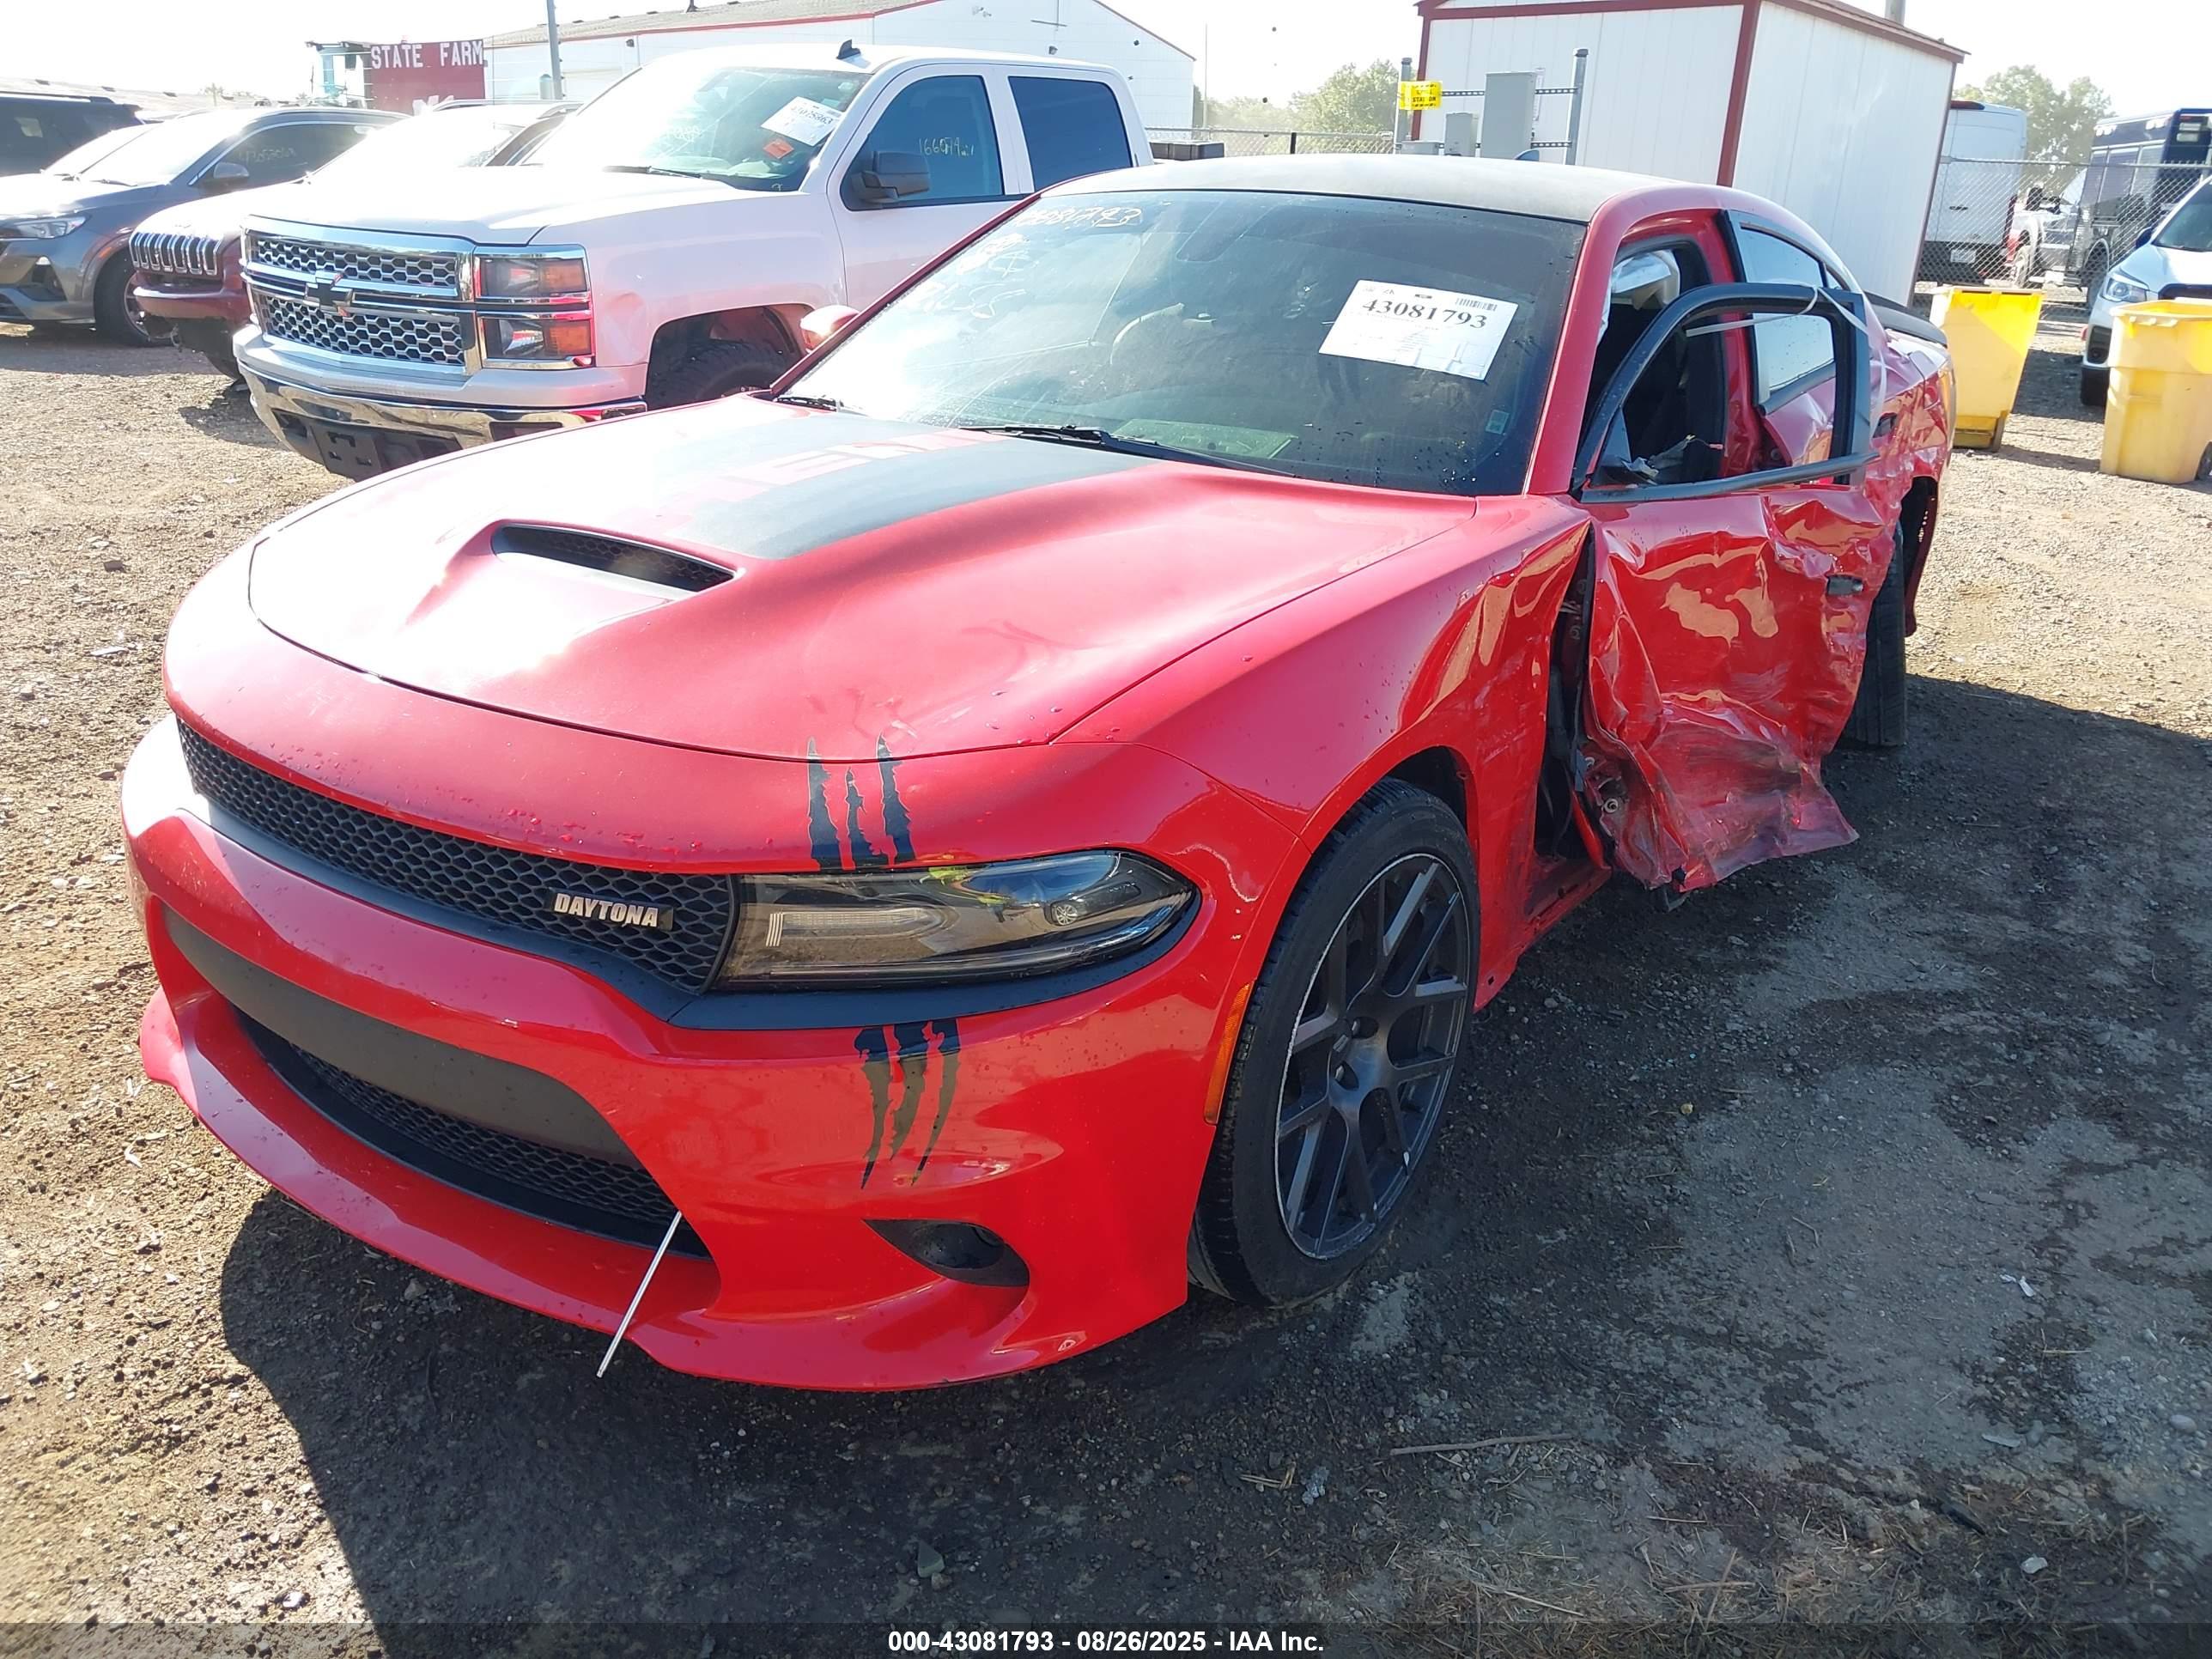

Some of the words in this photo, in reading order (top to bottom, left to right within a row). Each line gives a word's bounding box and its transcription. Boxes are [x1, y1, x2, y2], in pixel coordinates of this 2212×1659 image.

[371, 44, 423, 69] STATE
[440, 40, 483, 67] FARM
[1362, 299, 1488, 329] 43081793
[554, 893, 659, 927] DAYTONA
